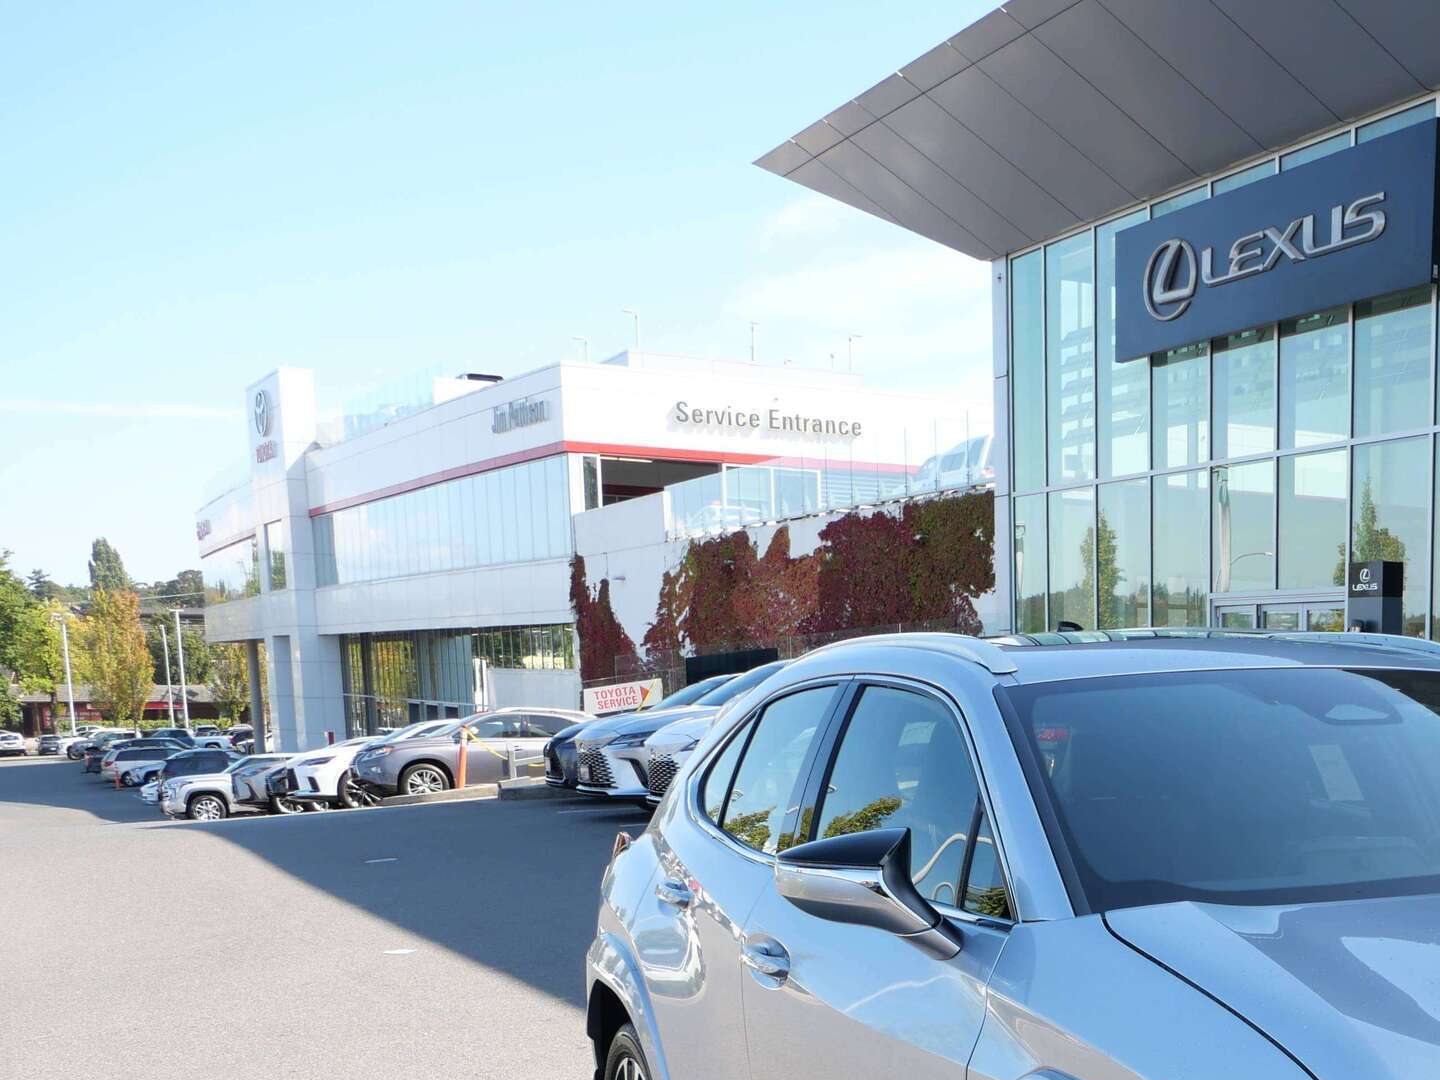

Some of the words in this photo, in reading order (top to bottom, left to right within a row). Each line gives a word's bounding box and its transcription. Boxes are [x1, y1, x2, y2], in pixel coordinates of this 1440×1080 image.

[1201, 191, 1386, 288] LEXUS
[675, 401, 760, 428] Service
[768, 409, 862, 437] Entrance
[594, 686, 636, 700] TOYOTA
[597, 695, 638, 710] SERVICE
